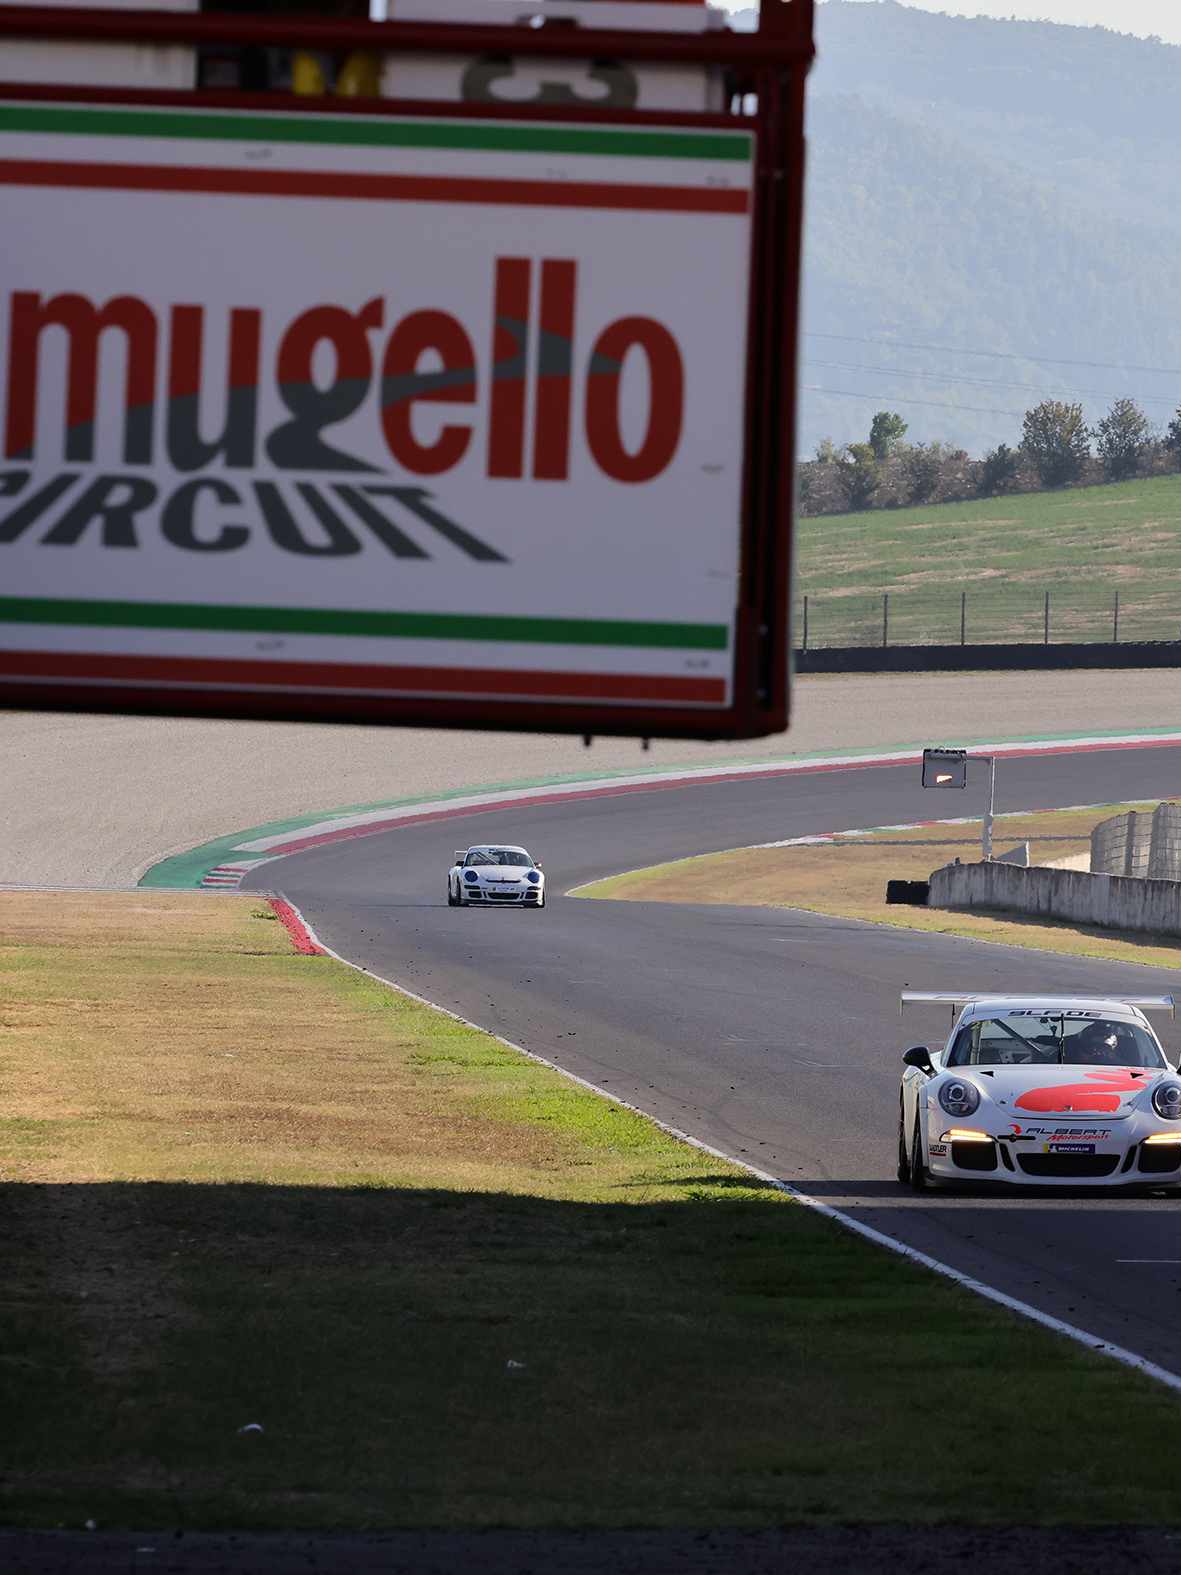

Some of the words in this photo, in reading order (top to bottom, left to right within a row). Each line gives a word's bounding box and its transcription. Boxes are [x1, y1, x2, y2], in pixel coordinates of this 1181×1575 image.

[4, 256, 685, 484] mugello
[0, 471, 512, 564] IRCUIT
[970, 1019, 990, 1030] 21
[1025, 1127, 1112, 1136] ALBERT
